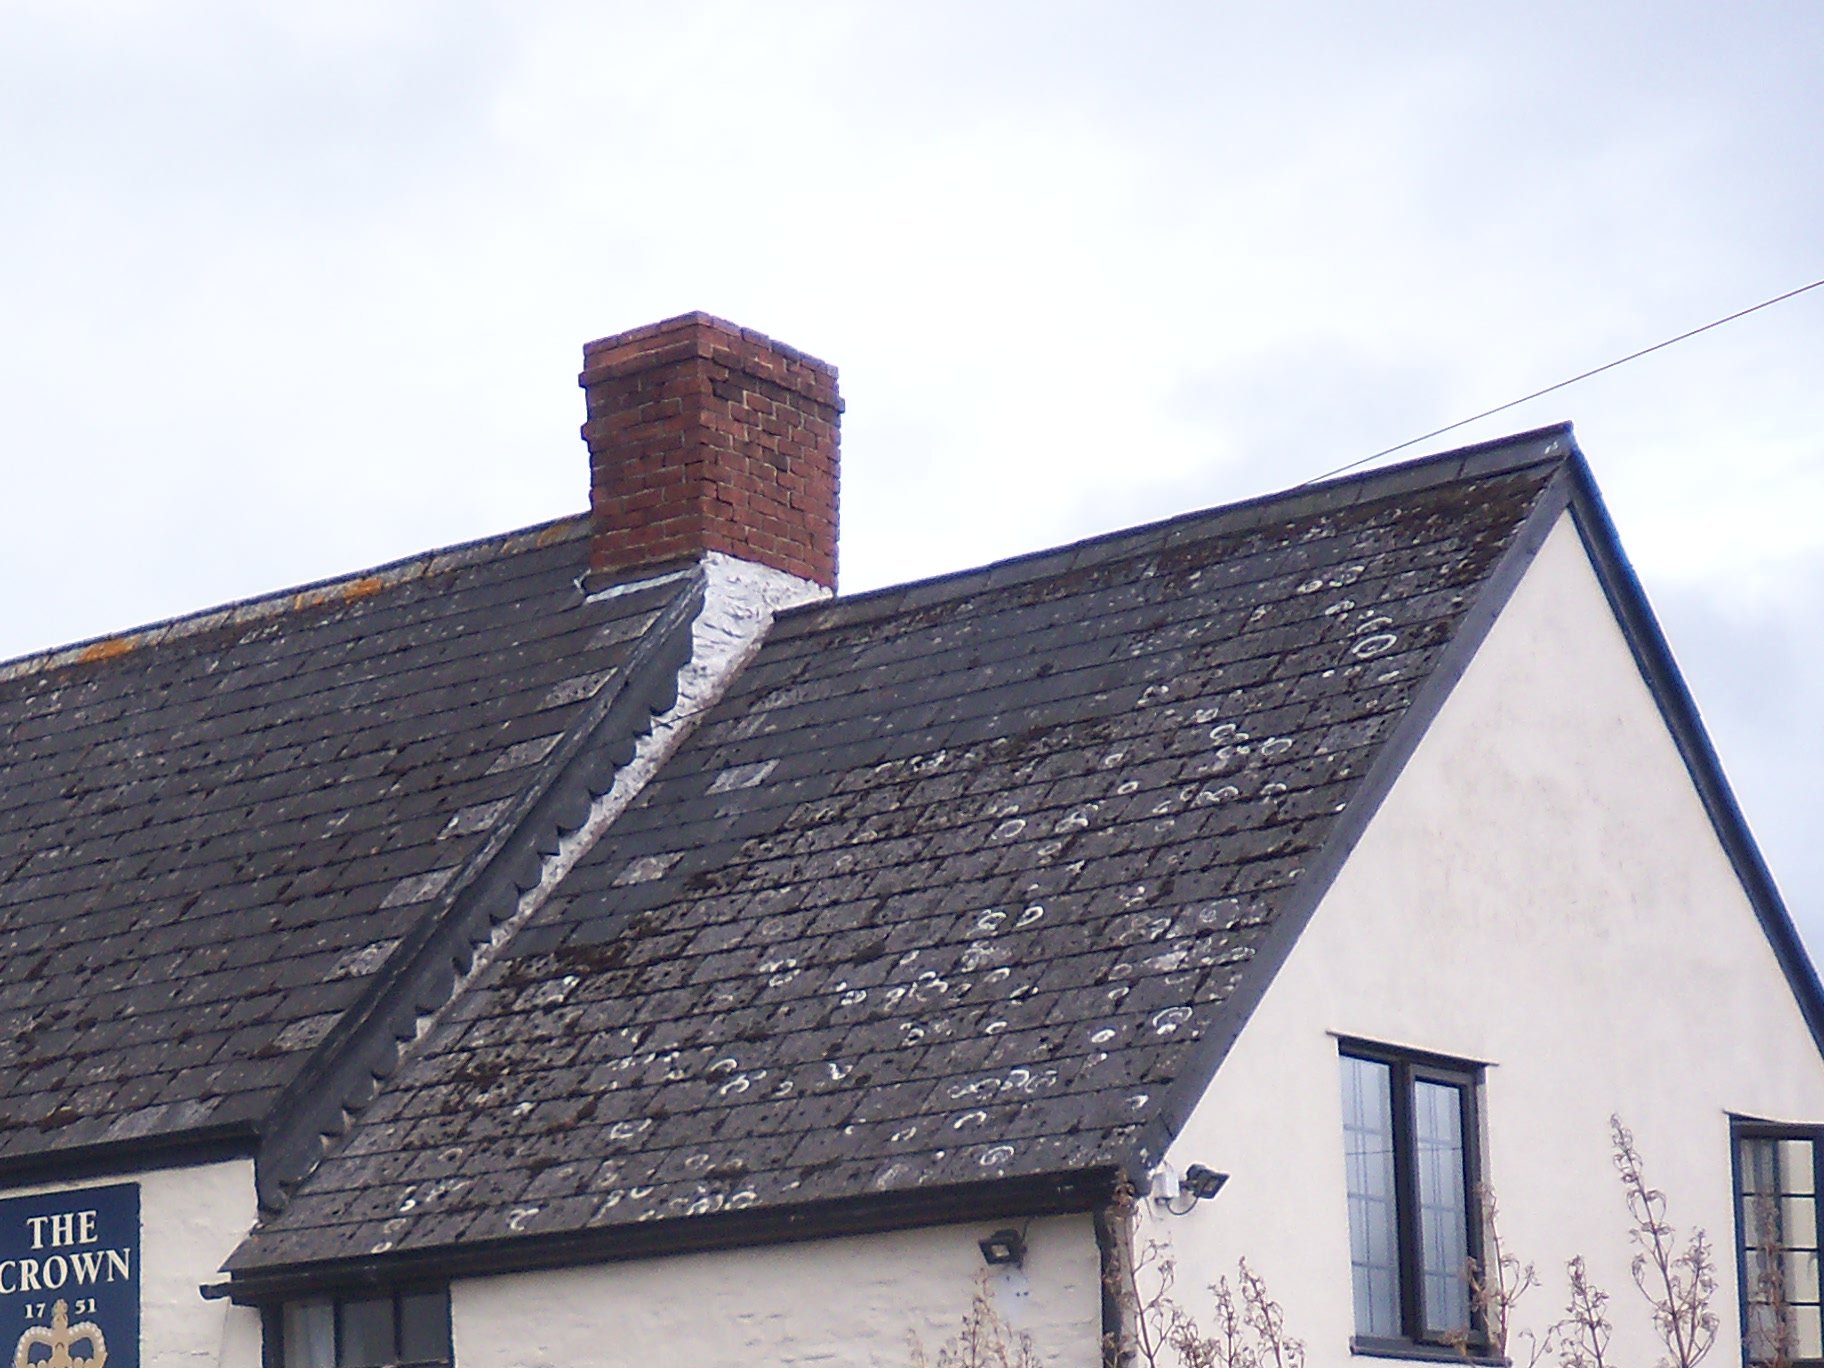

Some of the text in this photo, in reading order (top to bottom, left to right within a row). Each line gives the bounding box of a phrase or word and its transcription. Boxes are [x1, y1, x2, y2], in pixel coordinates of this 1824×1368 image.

[26, 1210, 97, 1249] THE
[25, 1298, 96, 1319] 17 51
